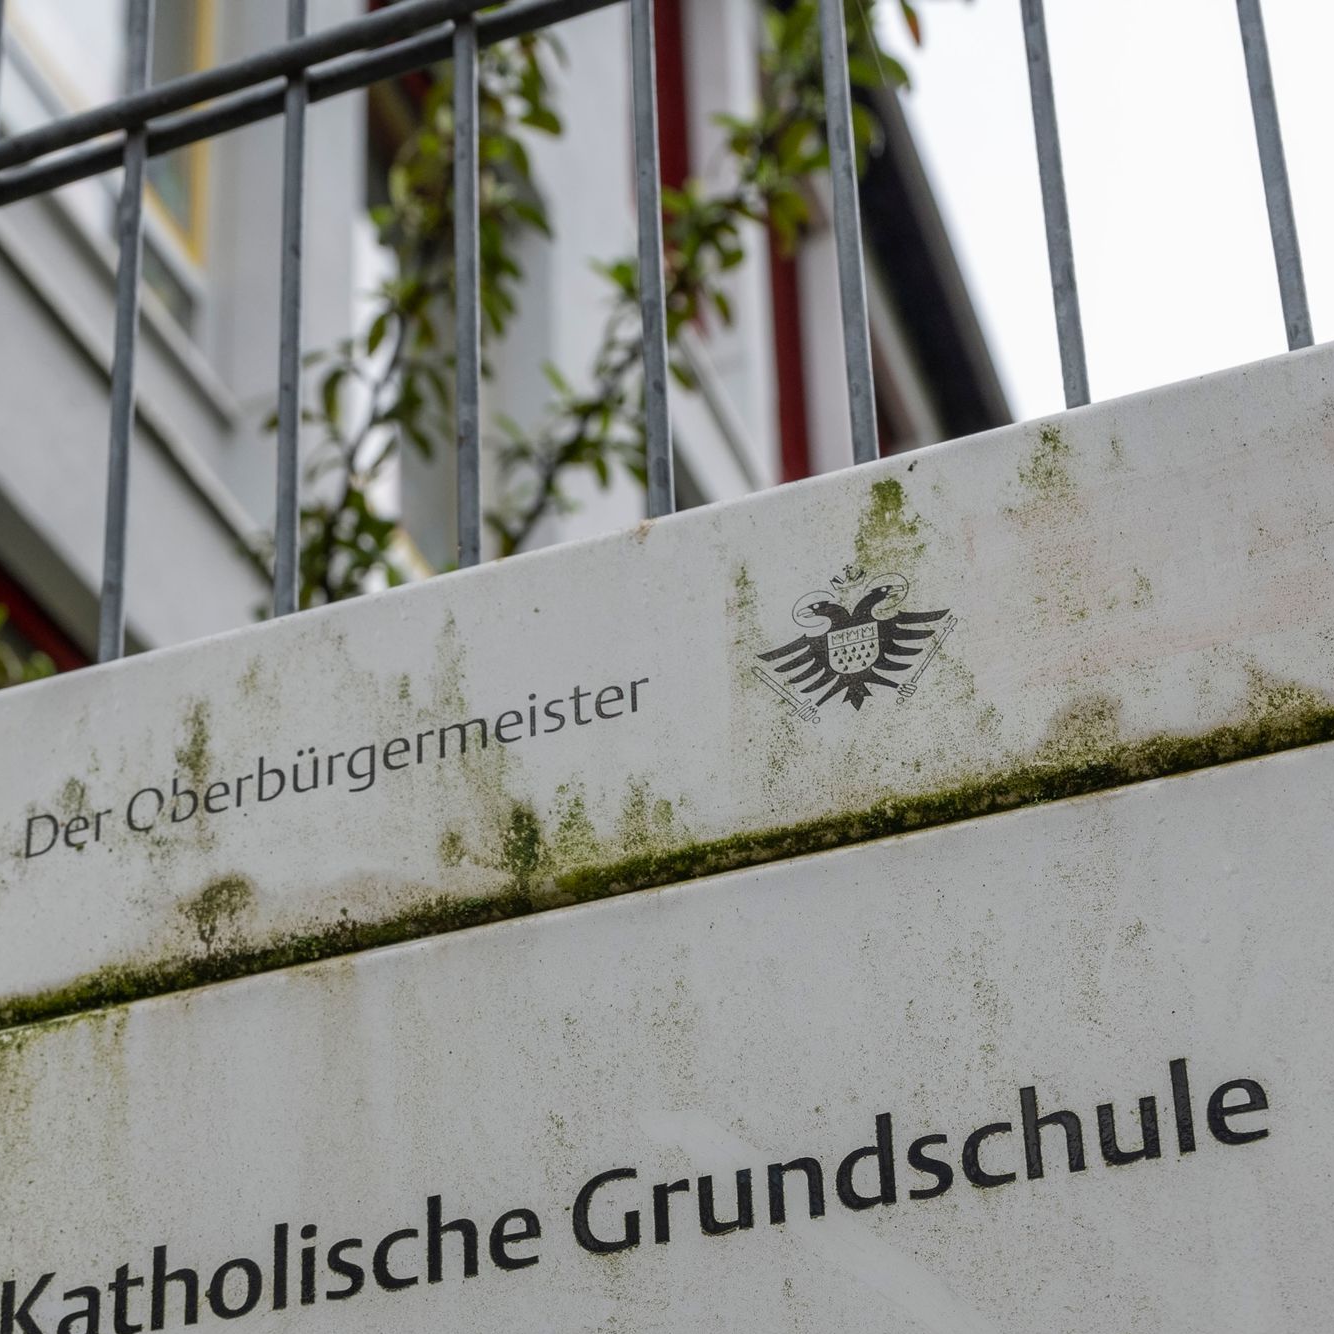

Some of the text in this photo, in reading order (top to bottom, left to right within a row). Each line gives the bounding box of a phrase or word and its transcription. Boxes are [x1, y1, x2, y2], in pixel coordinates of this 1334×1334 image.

[24, 676, 649, 859] Der Oberbürgermeister
[572, 1057, 1270, 1257] Grundschule
